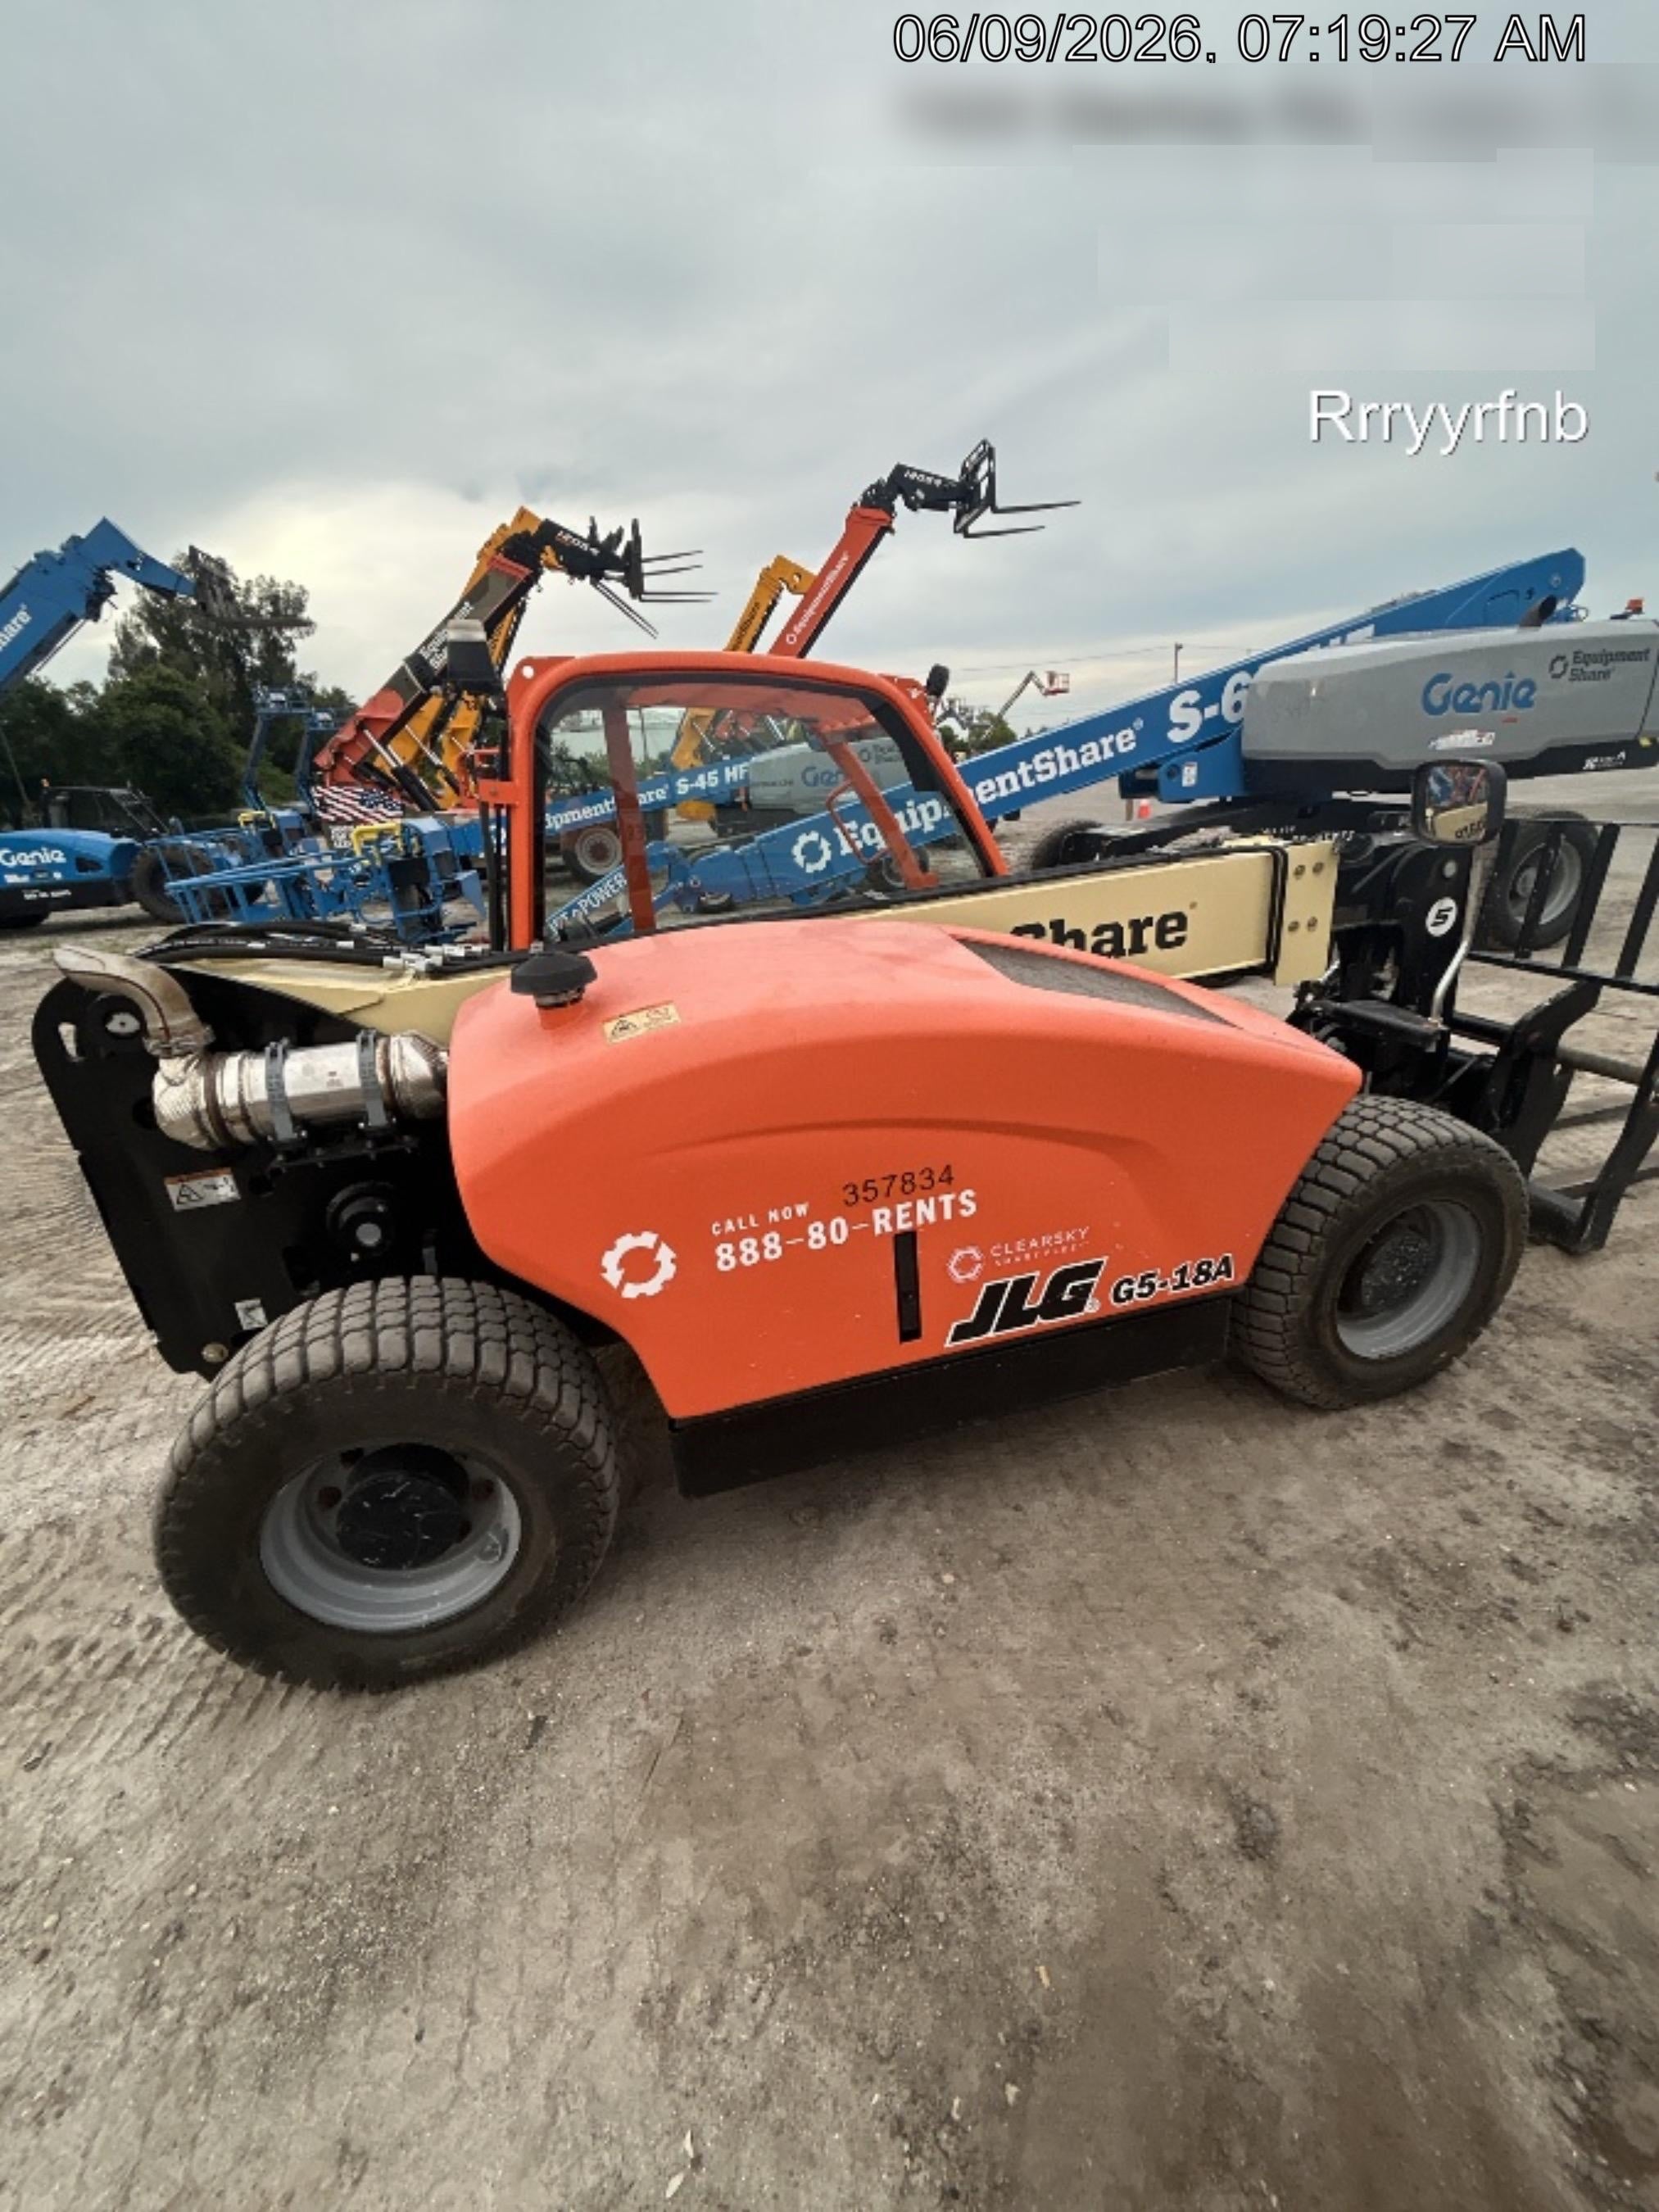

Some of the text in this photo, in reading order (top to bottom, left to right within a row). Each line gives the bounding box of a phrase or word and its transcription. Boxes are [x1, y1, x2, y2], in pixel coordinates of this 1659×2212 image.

[1167, 670, 1251, 743] S-6
[1421, 670, 1537, 716] Genie
[676, 762, 750, 796] S-45 HF
[841, 1164, 954, 1207] 357834
[711, 1201, 809, 1236] CALL NOW
[714, 1188, 977, 1271] 888-80-RENTS
[990, 1226, 1090, 1258] CLEARSKY
[945, 1253, 1234, 1348] JLG G5-18A
